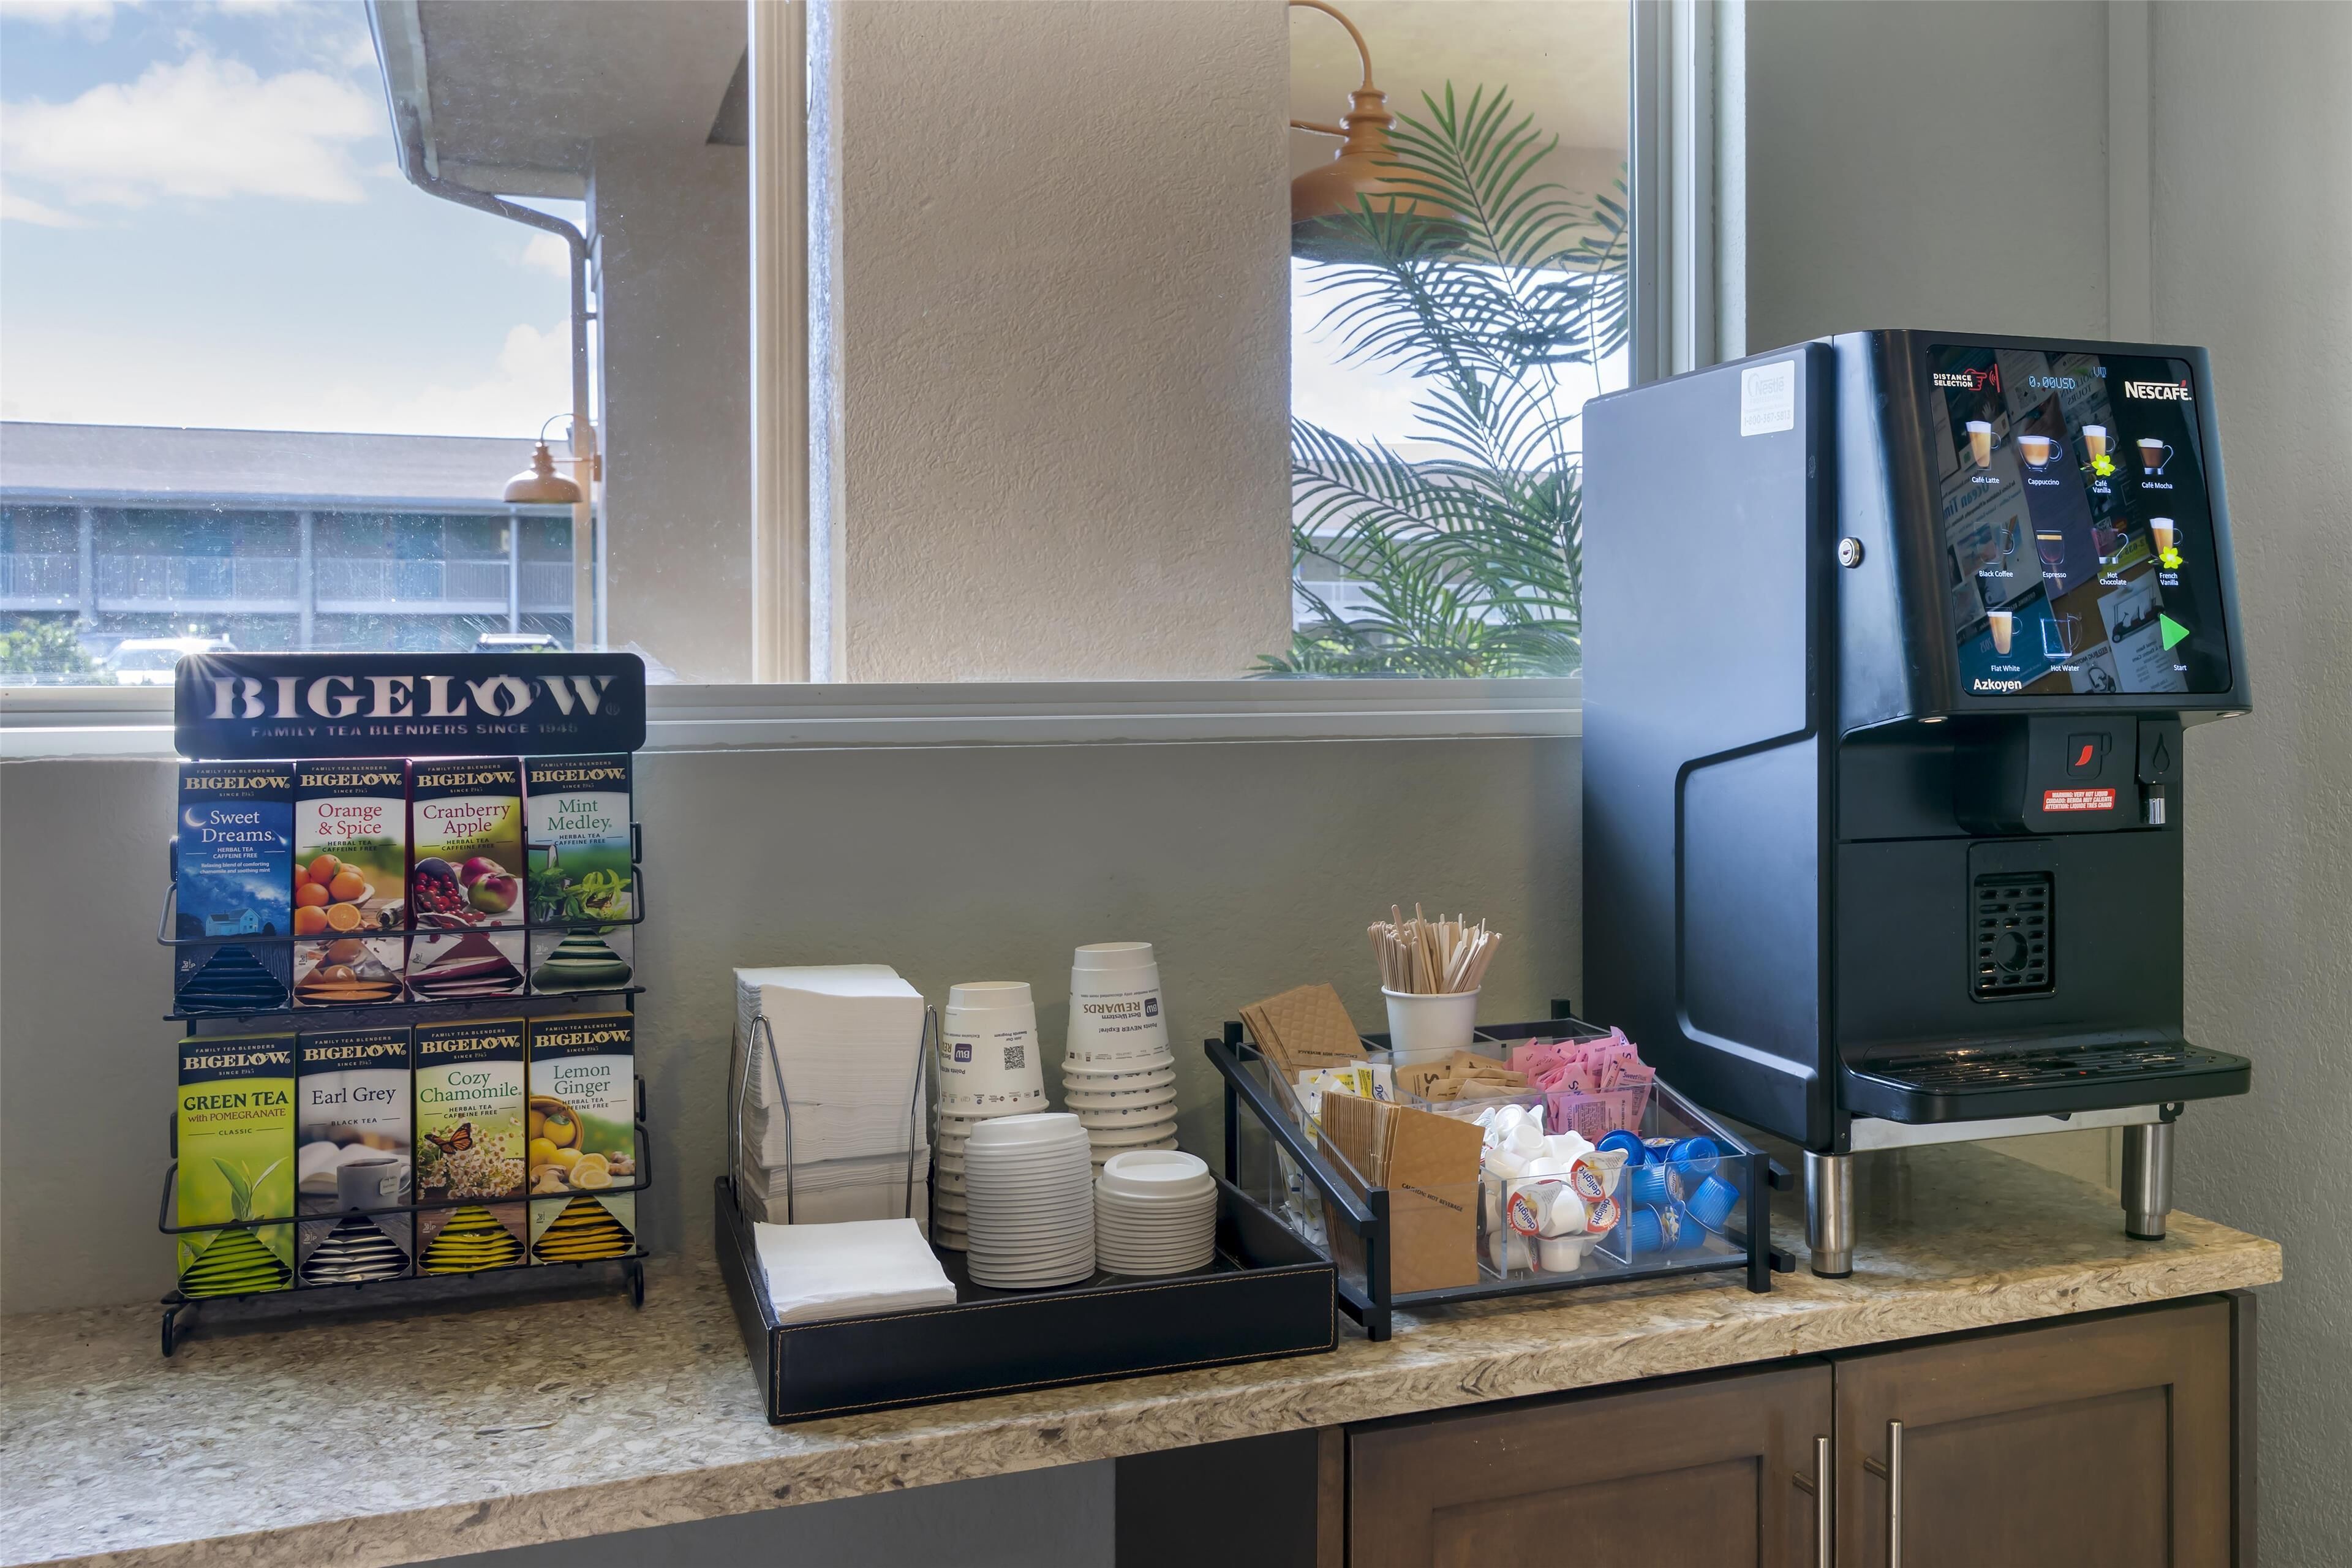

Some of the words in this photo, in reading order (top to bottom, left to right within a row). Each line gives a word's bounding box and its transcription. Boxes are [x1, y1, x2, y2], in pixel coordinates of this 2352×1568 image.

[2124, 379, 2188, 401] NESCAFÉ
[1973, 678, 2022, 692] Azkoyen
[206, 674, 619, 719] BIGELOW
[251, 725, 317, 737] FAMILY
[326, 725, 362, 736] TEA
[370, 724, 468, 736] BLENDERS
[477, 723, 530, 734] SINCE
[184, 777, 290, 790] BIGELOW
[300, 773, 402, 786] BIGELOW
[417, 771, 515, 787] BIGELOW
[530, 767, 625, 783] BIGELOW
[318, 803, 382, 821] Orange
[423, 803, 511, 820] Cranberry
[559, 799, 598, 813] Mint
[210, 810, 260, 824] Sweet
[548, 815, 611, 832] Medley
[202, 828, 273, 843] Dreams
[318, 821, 333, 835] &
[337, 820, 382, 839] Spice
[443, 818, 492, 837] Apple
[1084, 1001, 1140, 1014] REWARDS
[1146, 1004, 1158, 1014] BW
[420, 1035, 520, 1054] BIGELOW
[534, 1030, 630, 1047] BIGELOW
[303, 1042, 406, 1061] BIGELOW
[956, 1050, 970, 1058] BW
[183, 1051, 290, 1070] BIGELOW
[448, 1071, 491, 1088] Cozy
[554, 1065, 611, 1079] Lemon
[311, 1087, 348, 1105] Earl
[353, 1087, 396, 1104] Grey
[420, 1082, 518, 1103] Chamomile
[554, 1080, 611, 1097] Ginger
[184, 1093, 247, 1111] GREEN
[251, 1090, 289, 1106] TEA
[187, 1114, 208, 1123] with
[210, 1108, 286, 1121] POMEGRANATE
[219, 1128, 253, 1136] CLASSIC
[1577, 1166, 1602, 1196] delight
[1427, 1194, 1439, 1202] HOT
[1439, 1197, 1464, 1213] BEVERAGE
[1592, 1198, 1611, 1225] delight
[1515, 1200, 1536, 1230] delight
